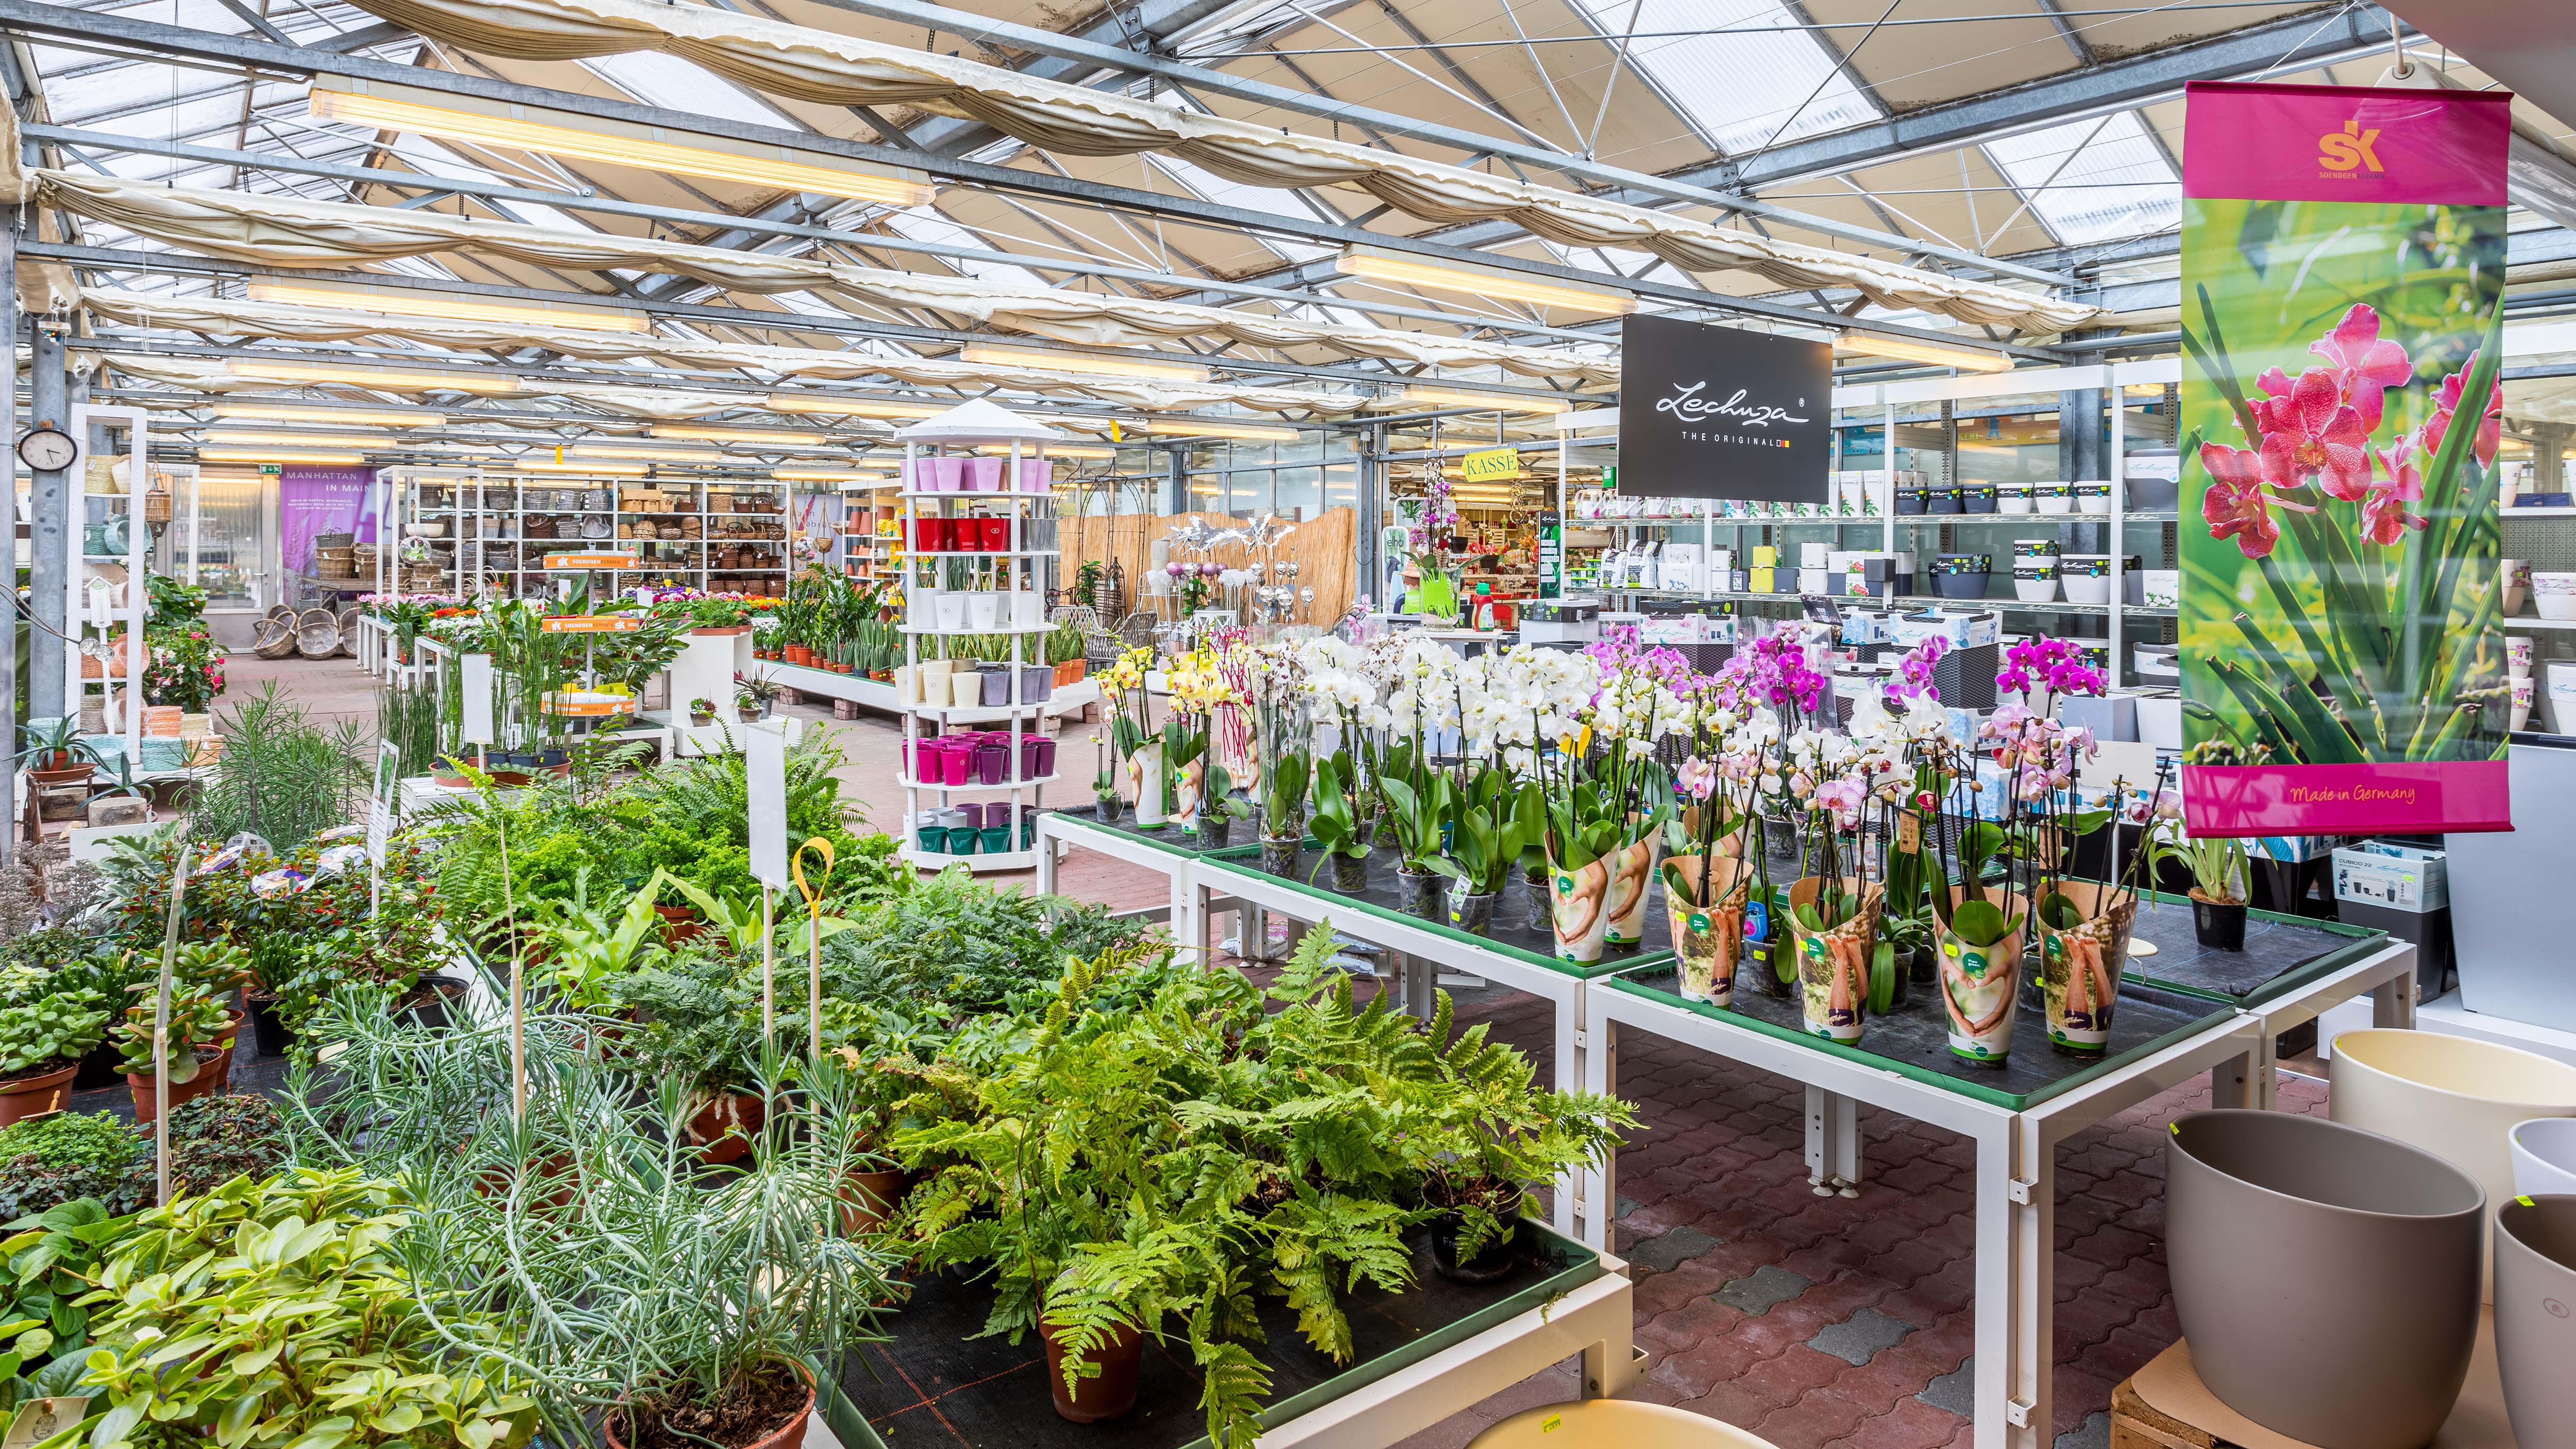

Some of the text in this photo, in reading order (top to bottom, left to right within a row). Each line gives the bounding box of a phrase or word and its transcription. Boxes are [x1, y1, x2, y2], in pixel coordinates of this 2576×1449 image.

[1656, 381, 1809, 427] Lechuza
[1682, 432, 1773, 446] THE ORIGINAL
[1466, 455, 1517, 475] KASSE
[286, 472, 357, 480] MANHATTAN
[1387, 536, 1404, 547] elho
[2291, 785, 2415, 804] Made in Germany
